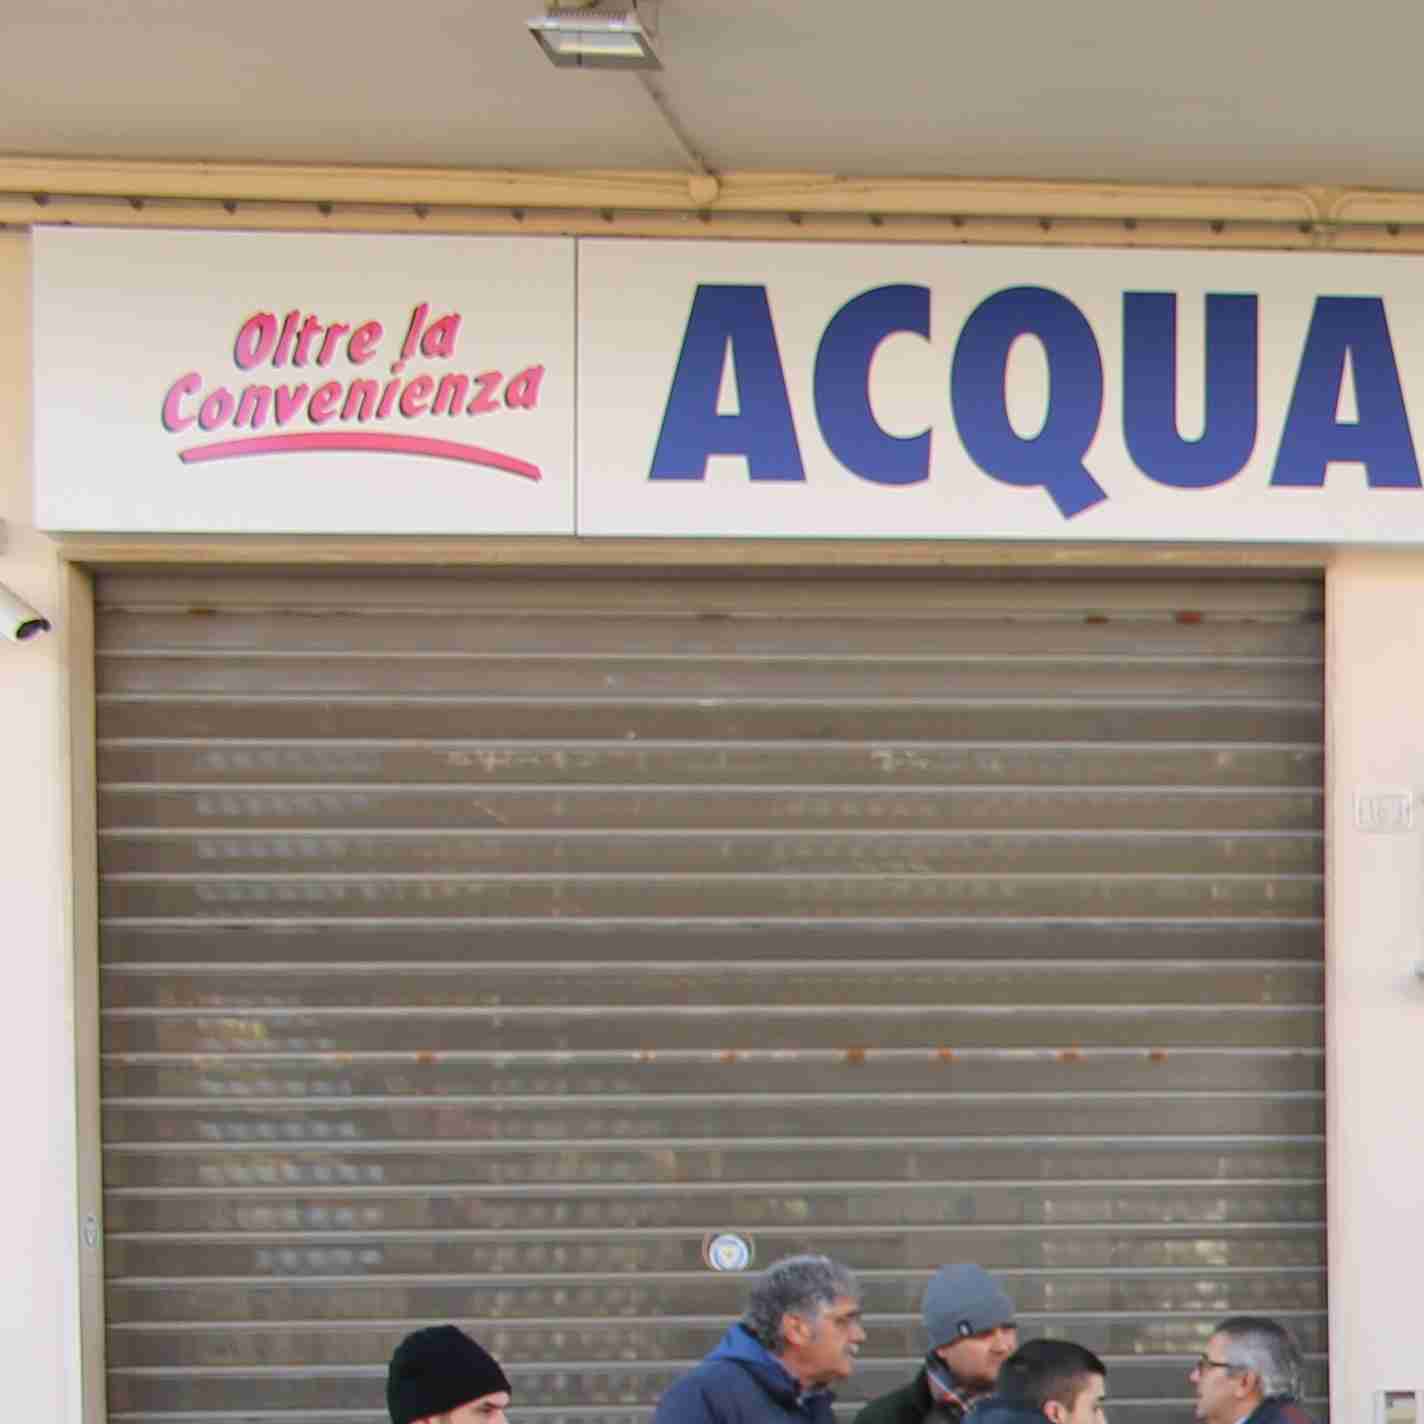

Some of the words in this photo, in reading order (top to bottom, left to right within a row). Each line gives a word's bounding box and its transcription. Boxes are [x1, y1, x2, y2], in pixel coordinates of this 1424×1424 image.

[234, 309, 385, 371] Oltre
[398, 302, 463, 363] la
[161, 362, 545, 432] Convenienza
[647, 281, 1424, 520] ACQUA
